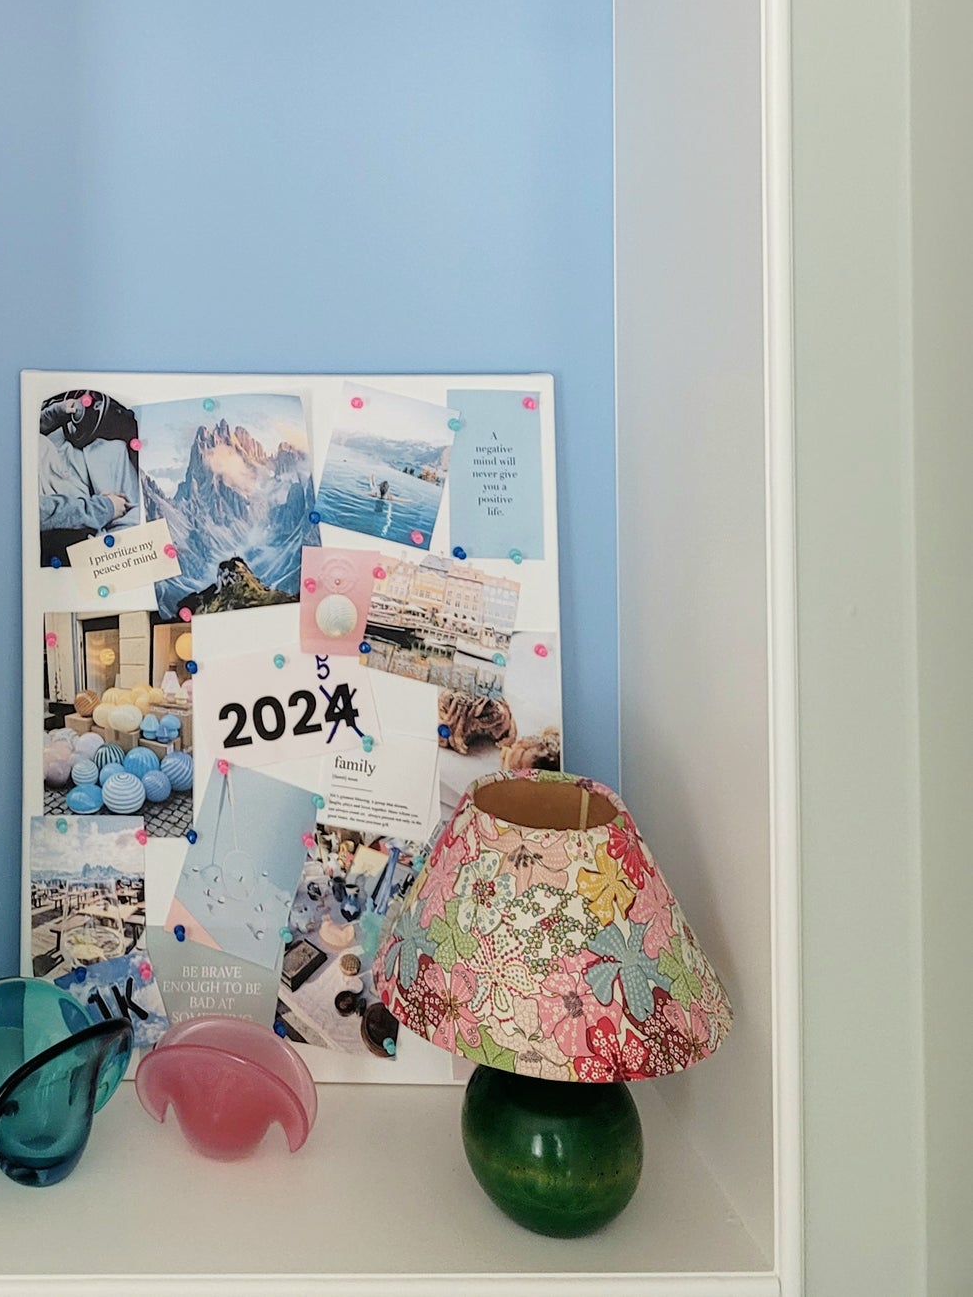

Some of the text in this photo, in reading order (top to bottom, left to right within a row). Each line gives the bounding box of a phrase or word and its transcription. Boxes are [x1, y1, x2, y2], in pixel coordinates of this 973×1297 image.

[491, 431, 498, 440] A
[475, 444, 513, 456] negative
[473, 456, 516, 466] mind will
[499, 469, 518, 481] give
[482, 484, 499, 493] you
[478, 494, 513, 506] positive
[487, 506, 504, 516] life.
[94, 546, 138, 566] prioritize
[139, 540, 153, 552] my
[93, 550, 158, 579] peace of mind
[315, 654, 331, 680] 5
[218, 683, 360, 749] 2024
[334, 755, 376, 777] family
[182, 965, 242, 979] BE BRAVE
[162, 981, 263, 995] ENOUGH TO BE
[189, 996, 235, 1010] BAD AT
